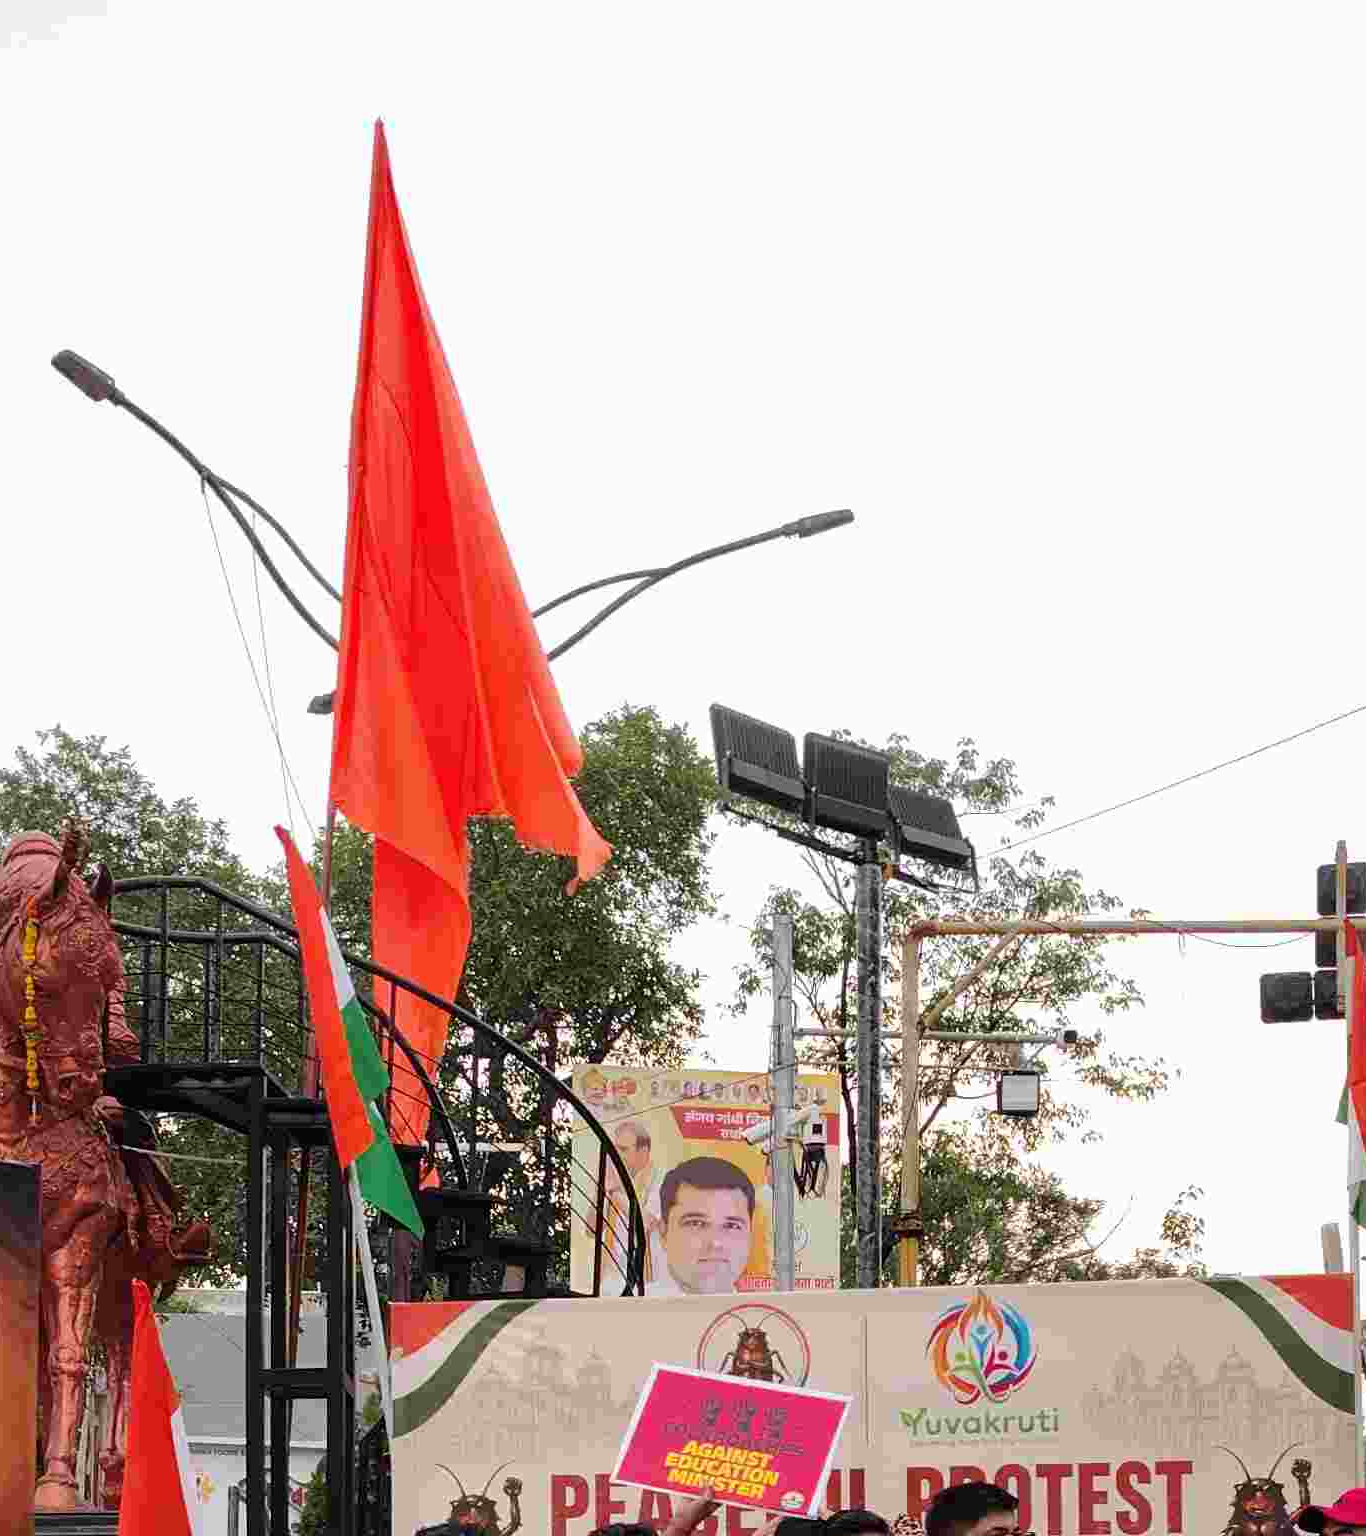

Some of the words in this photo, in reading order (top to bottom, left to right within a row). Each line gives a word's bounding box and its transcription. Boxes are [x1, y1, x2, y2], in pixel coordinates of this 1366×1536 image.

[899, 1407, 1059, 1436] Yuvakruti
[683, 1440, 772, 1469] AGAINST
[666, 1453, 779, 1487] EDUCATION
[668, 1469, 765, 1498] MINISTER
[907, 1461, 1194, 1536] POTEST
